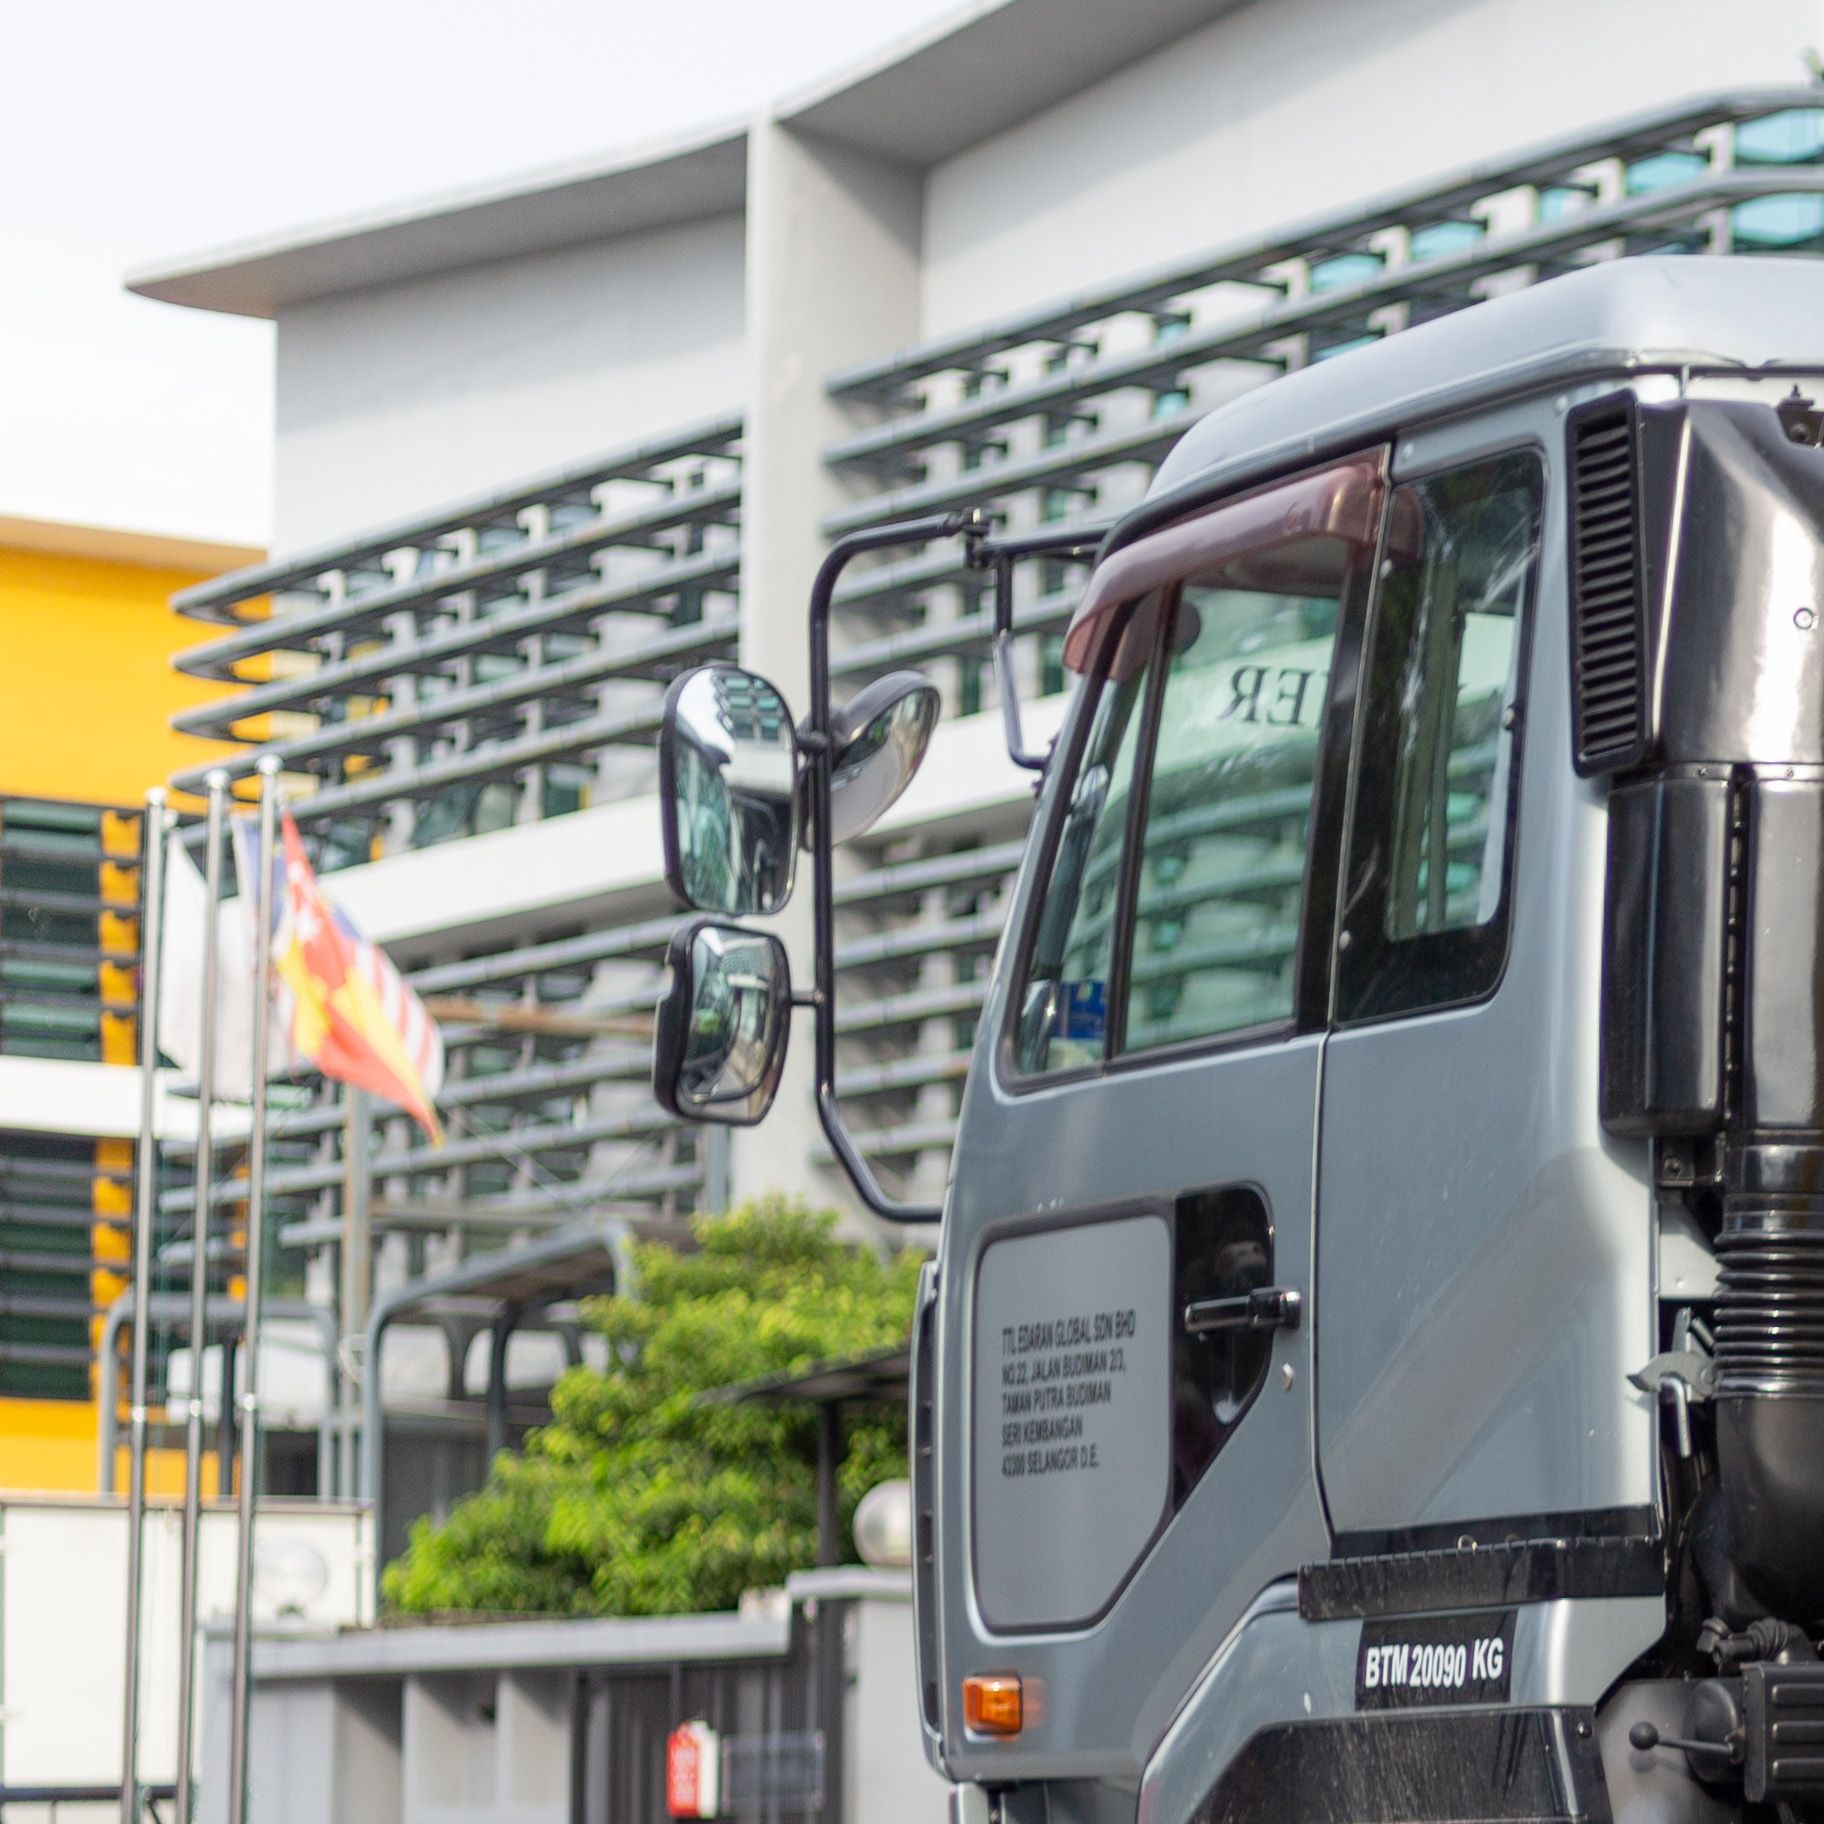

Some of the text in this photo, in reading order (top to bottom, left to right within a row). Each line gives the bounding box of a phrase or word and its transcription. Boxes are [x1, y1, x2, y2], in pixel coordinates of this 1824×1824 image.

[1055, 1315, 1091, 1348] GLOBAL
[1094, 1312, 1113, 1342] SDN
[1115, 1308, 1136, 1340] BHD
[1031, 1356, 1061, 1383] JALAN
[1365, 1637, 1504, 1689] BTM 20090 KG
